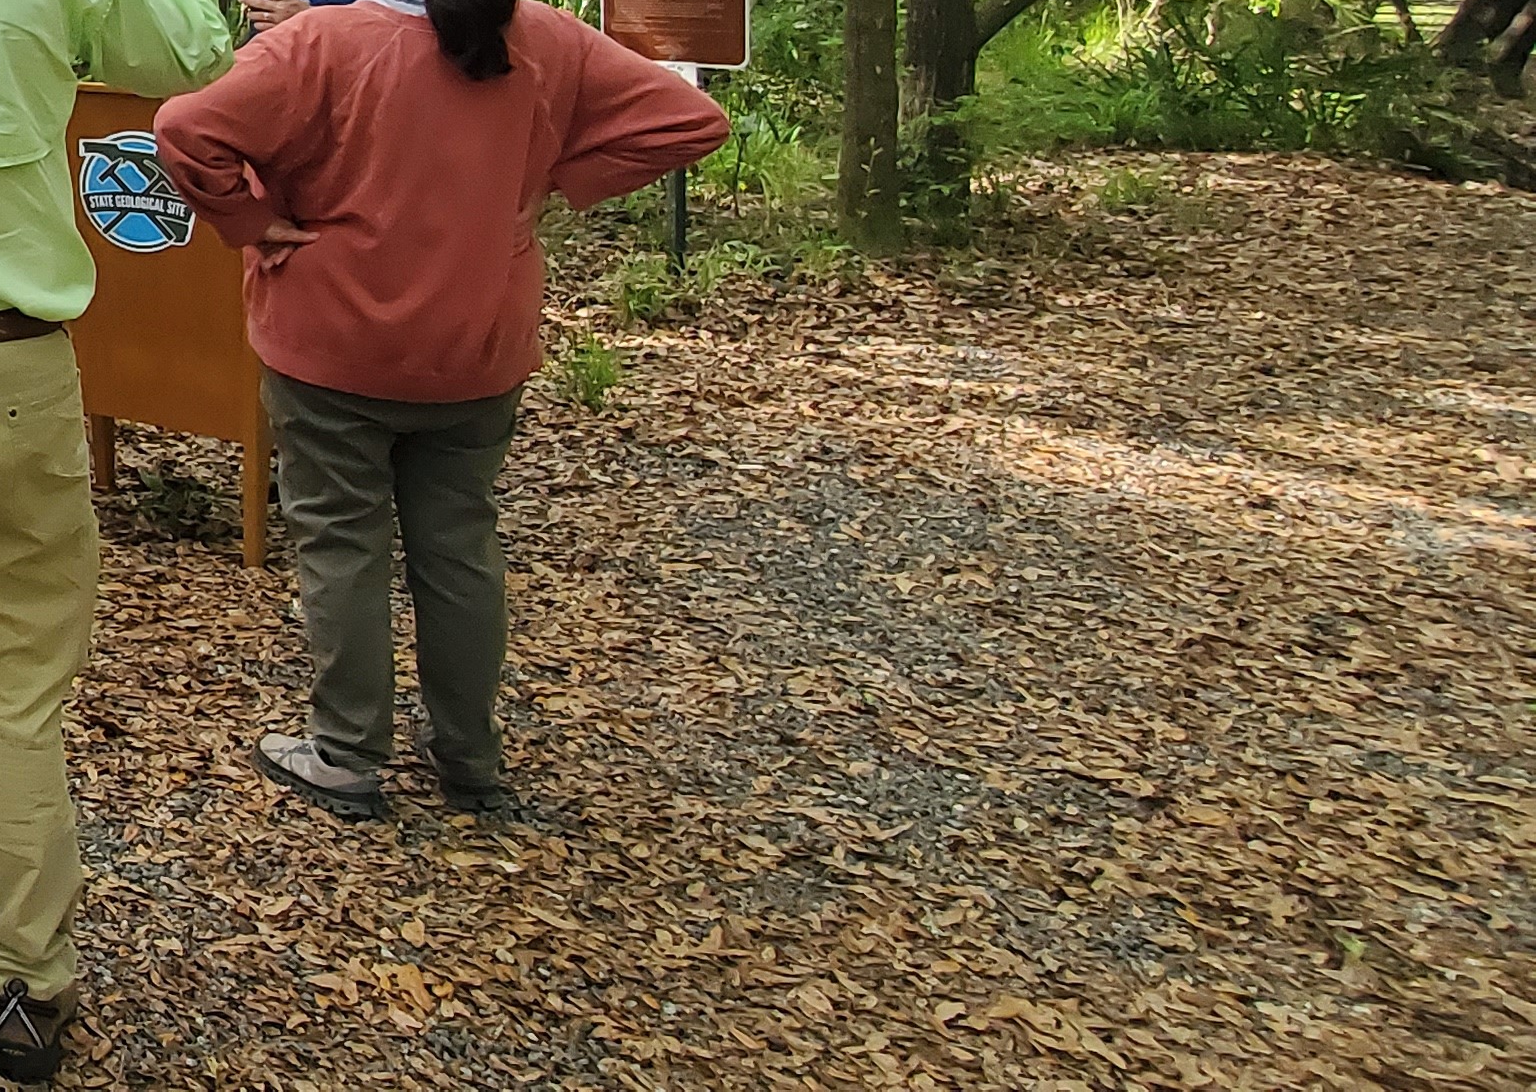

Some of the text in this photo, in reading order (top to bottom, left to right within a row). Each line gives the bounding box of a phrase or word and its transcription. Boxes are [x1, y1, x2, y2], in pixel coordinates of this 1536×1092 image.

[88, 194, 188, 217] STATE GEOLOGICAL SITE
